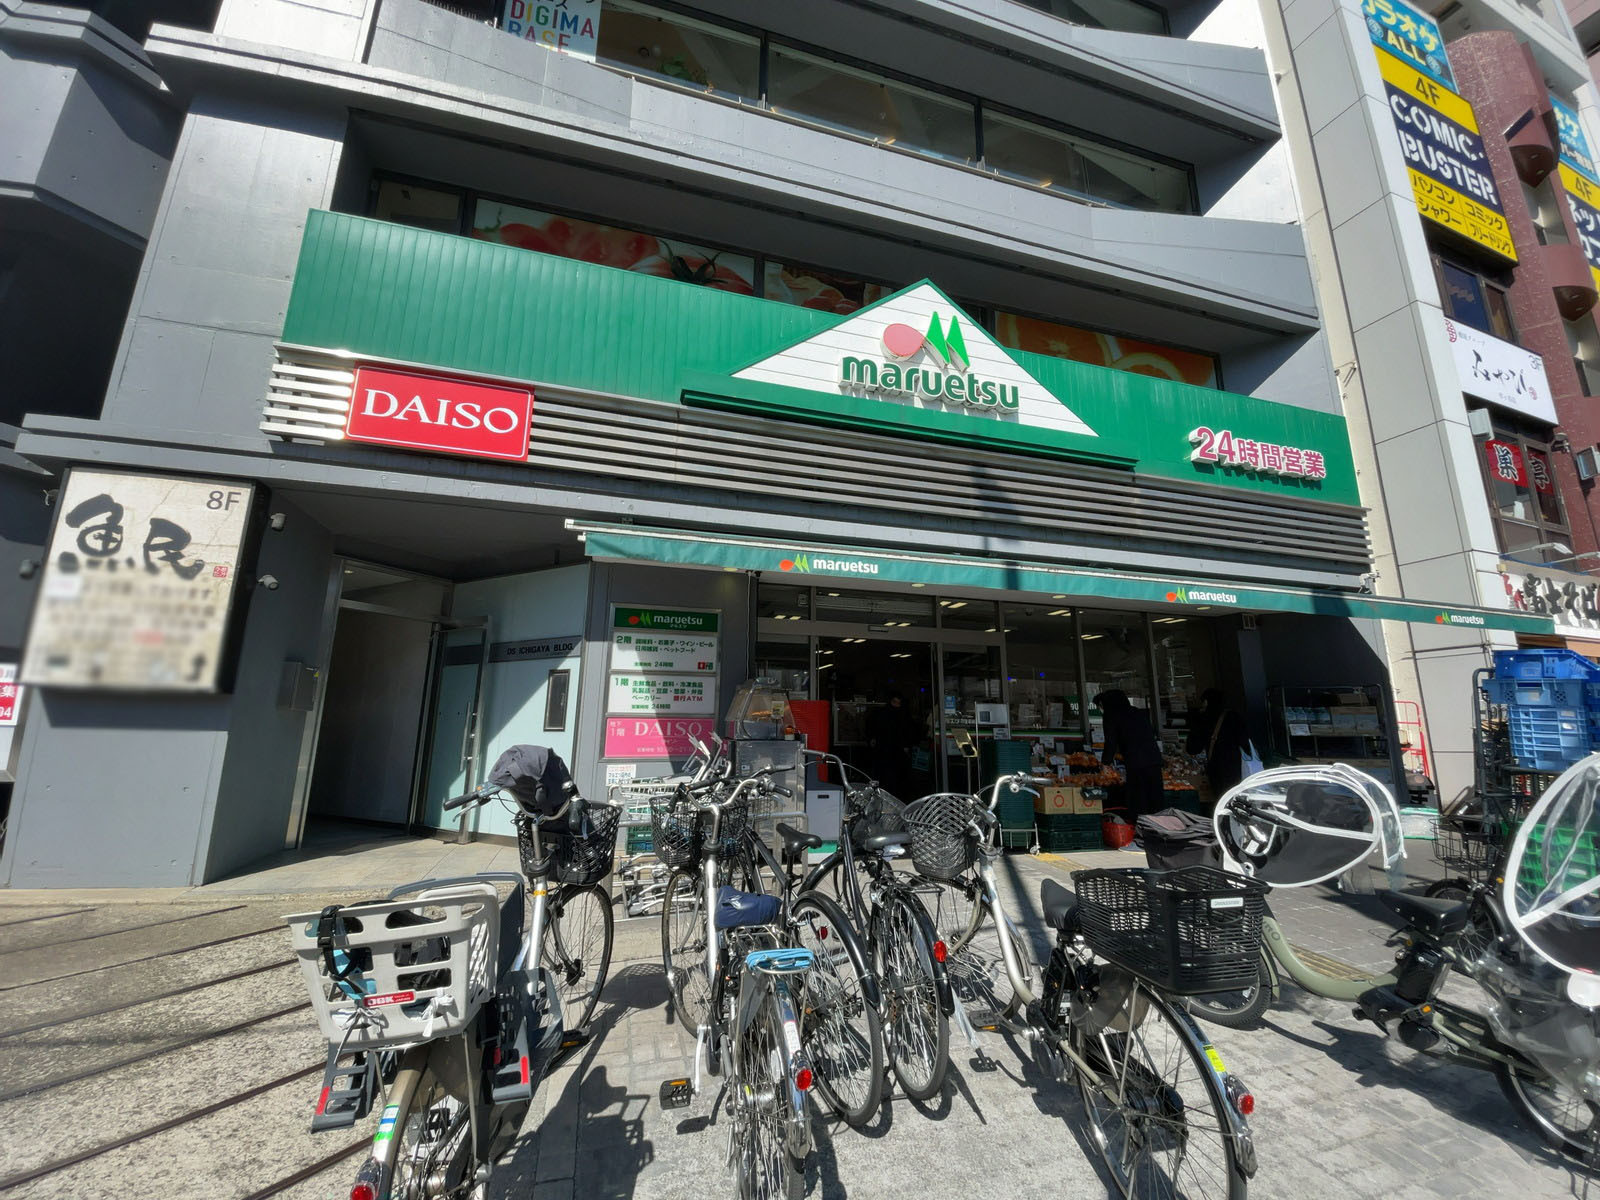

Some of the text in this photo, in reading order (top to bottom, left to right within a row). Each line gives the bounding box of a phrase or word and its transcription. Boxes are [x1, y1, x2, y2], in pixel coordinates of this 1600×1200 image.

[511, 0, 594, 39] DIGIMA
[1387, 29, 1426, 66] ALL
[1415, 77, 1440, 106] 4F
[1398, 129, 1498, 206] BUSTER
[1576, 177, 1593, 201] 4F
[1413, 174, 1503, 230] パソコン コミック
[1418, 196, 1462, 225] シャワー
[841, 356, 1020, 410] maruetsu
[361, 388, 519, 434] DAISO
[1191, 427, 1327, 480] 24時間営業
[206, 490, 242, 511] 8F
[813, 558, 879, 574] maruetsu
[1188, 590, 1238, 604] maruetsu
[653, 615, 703, 625] maruetsu
[1450, 614, 1485, 625] maruetsu
[519, 645, 551, 655] ICHIGAYA
[616, 635, 632, 644] 2階
[615, 677, 629, 686] 1階
[611, 721, 703, 736] 1階 DAISO
